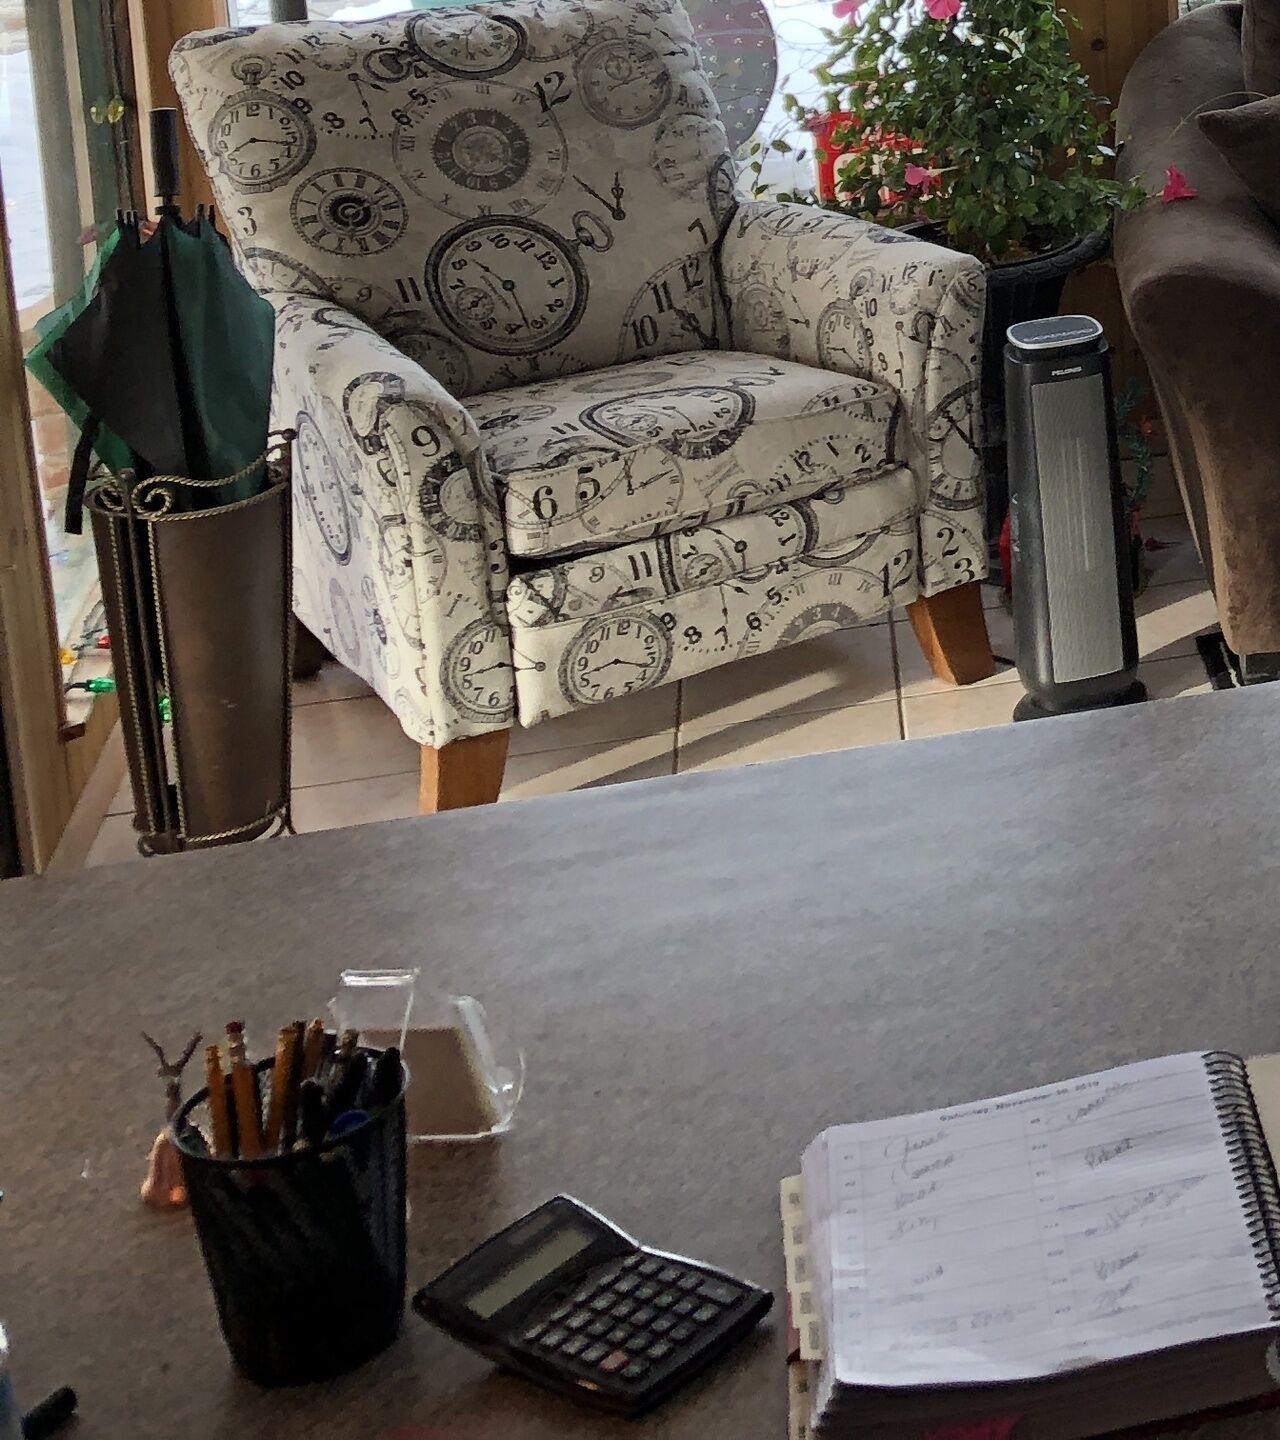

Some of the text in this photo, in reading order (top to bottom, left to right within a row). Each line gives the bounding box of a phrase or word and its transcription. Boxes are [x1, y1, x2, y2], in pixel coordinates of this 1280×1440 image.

[533, 71, 572, 113] 12
[411, 425, 441, 458] 9
[533, 485, 558, 521] 6
[936, 527, 961, 559] 2
[879, 548, 913, 598] 12
[954, 557, 976, 585] 3
[683, 625, 702, 644] 8
